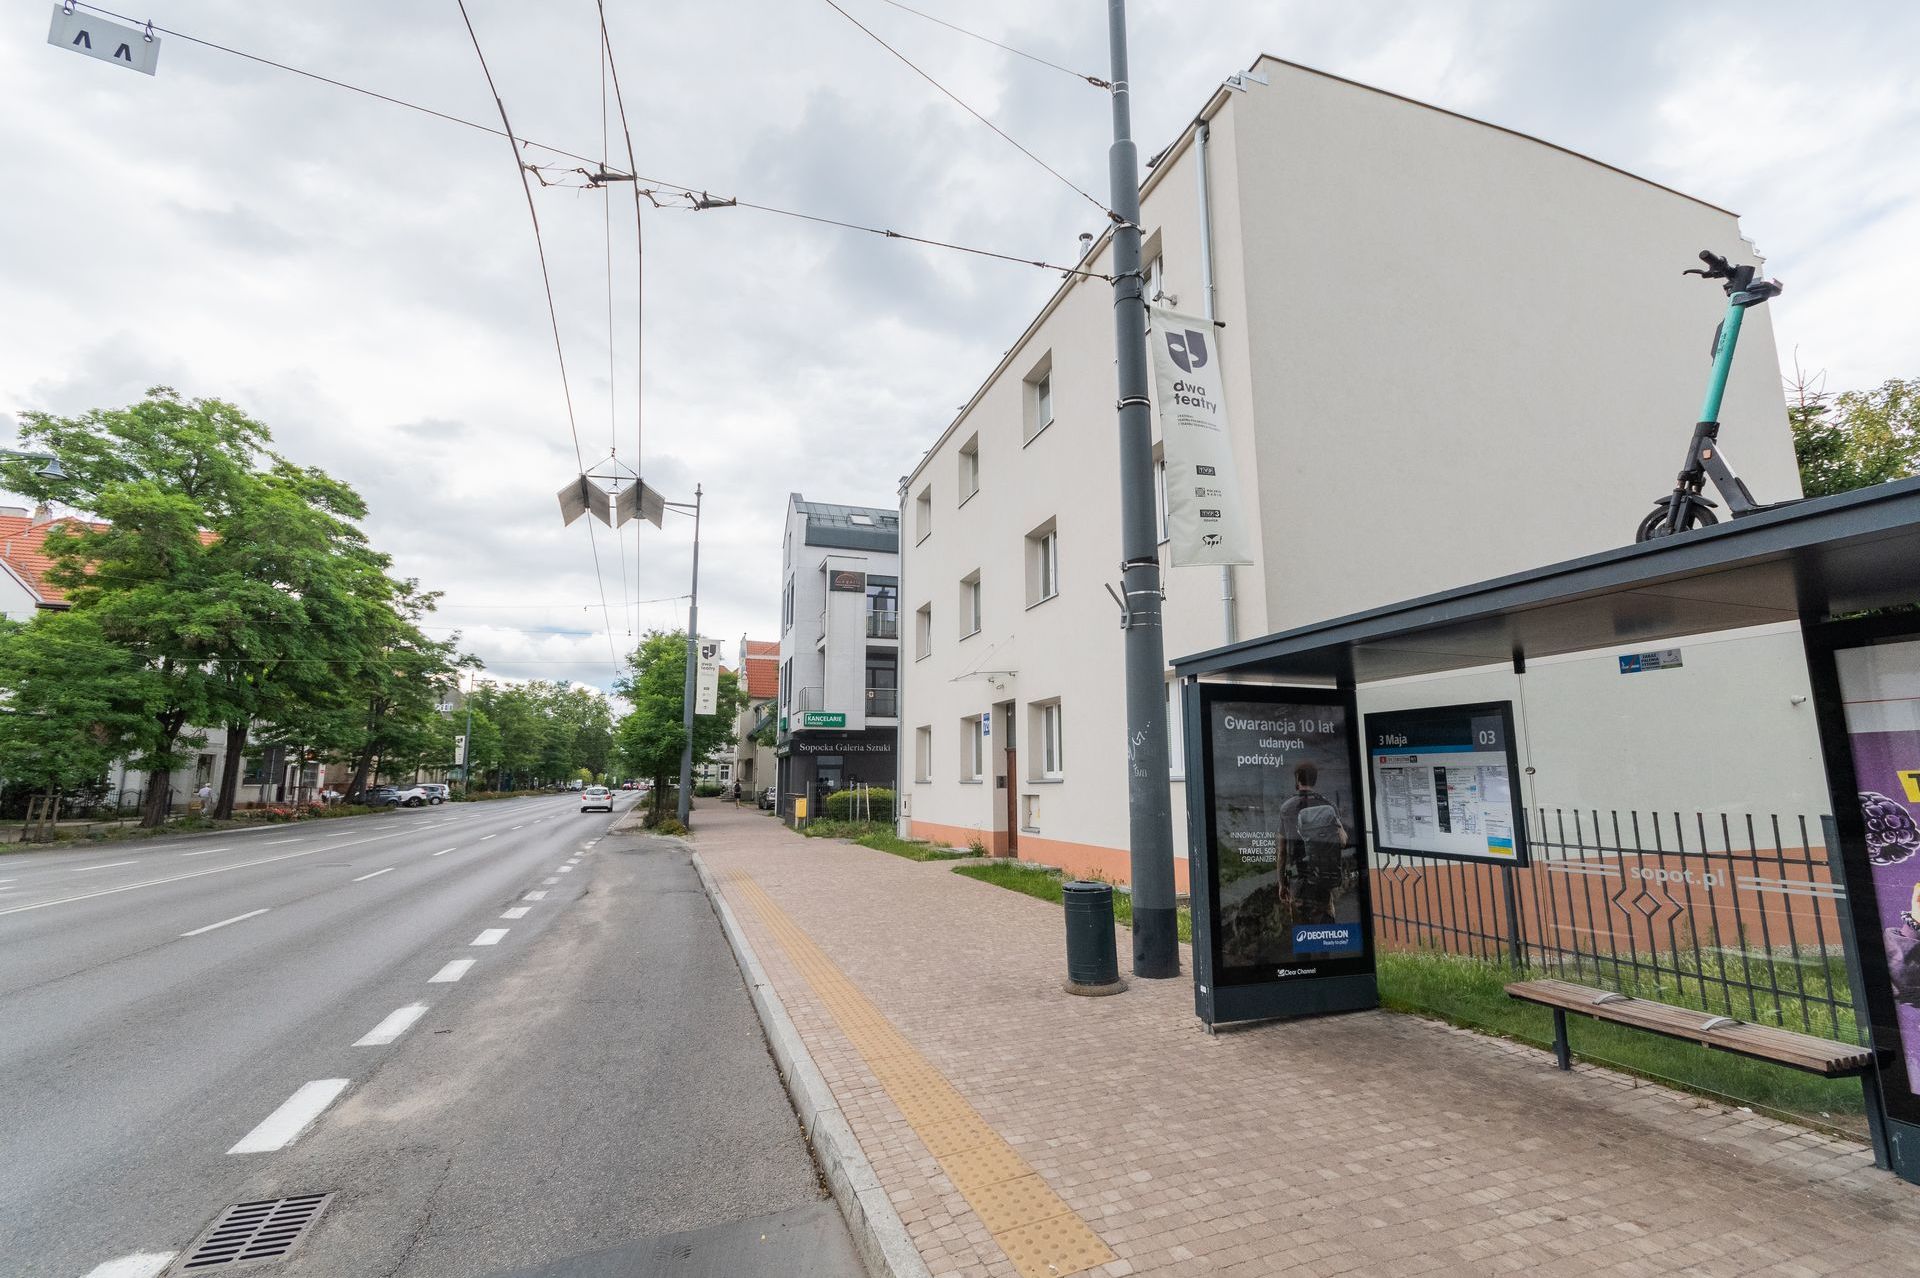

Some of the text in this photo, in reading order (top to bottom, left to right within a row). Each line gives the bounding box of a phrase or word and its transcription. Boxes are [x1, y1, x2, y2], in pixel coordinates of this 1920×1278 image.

[1173, 380, 1206, 396] dwa
[1174, 393, 1217, 414] teatry
[807, 715, 843, 723] KANCELARIE
[1224, 715, 1335, 735] Gwarancja 10 lat
[1379, 733, 1408, 748] 3 Maja
[1479, 730, 1496, 745] 03
[799, 743, 834, 754] Sopocka
[836, 743, 865, 752] Galeria
[866, 743, 891, 752] Sztuki
[1259, 737, 1305, 751] udanych
[1237, 753, 1284, 767] podróży!
[1230, 831, 1276, 839] INNOWACYJNY
[1251, 839, 1276, 847] PLECAK
[1239, 847, 1276, 855] TRAVEL 500
[1241, 855, 1277, 863] ORGANIZER
[1630, 866, 1725, 891] sopot.pl
[1307, 930, 1349, 940] DECATHLON
[1297, 967, 1316, 975] Channel
